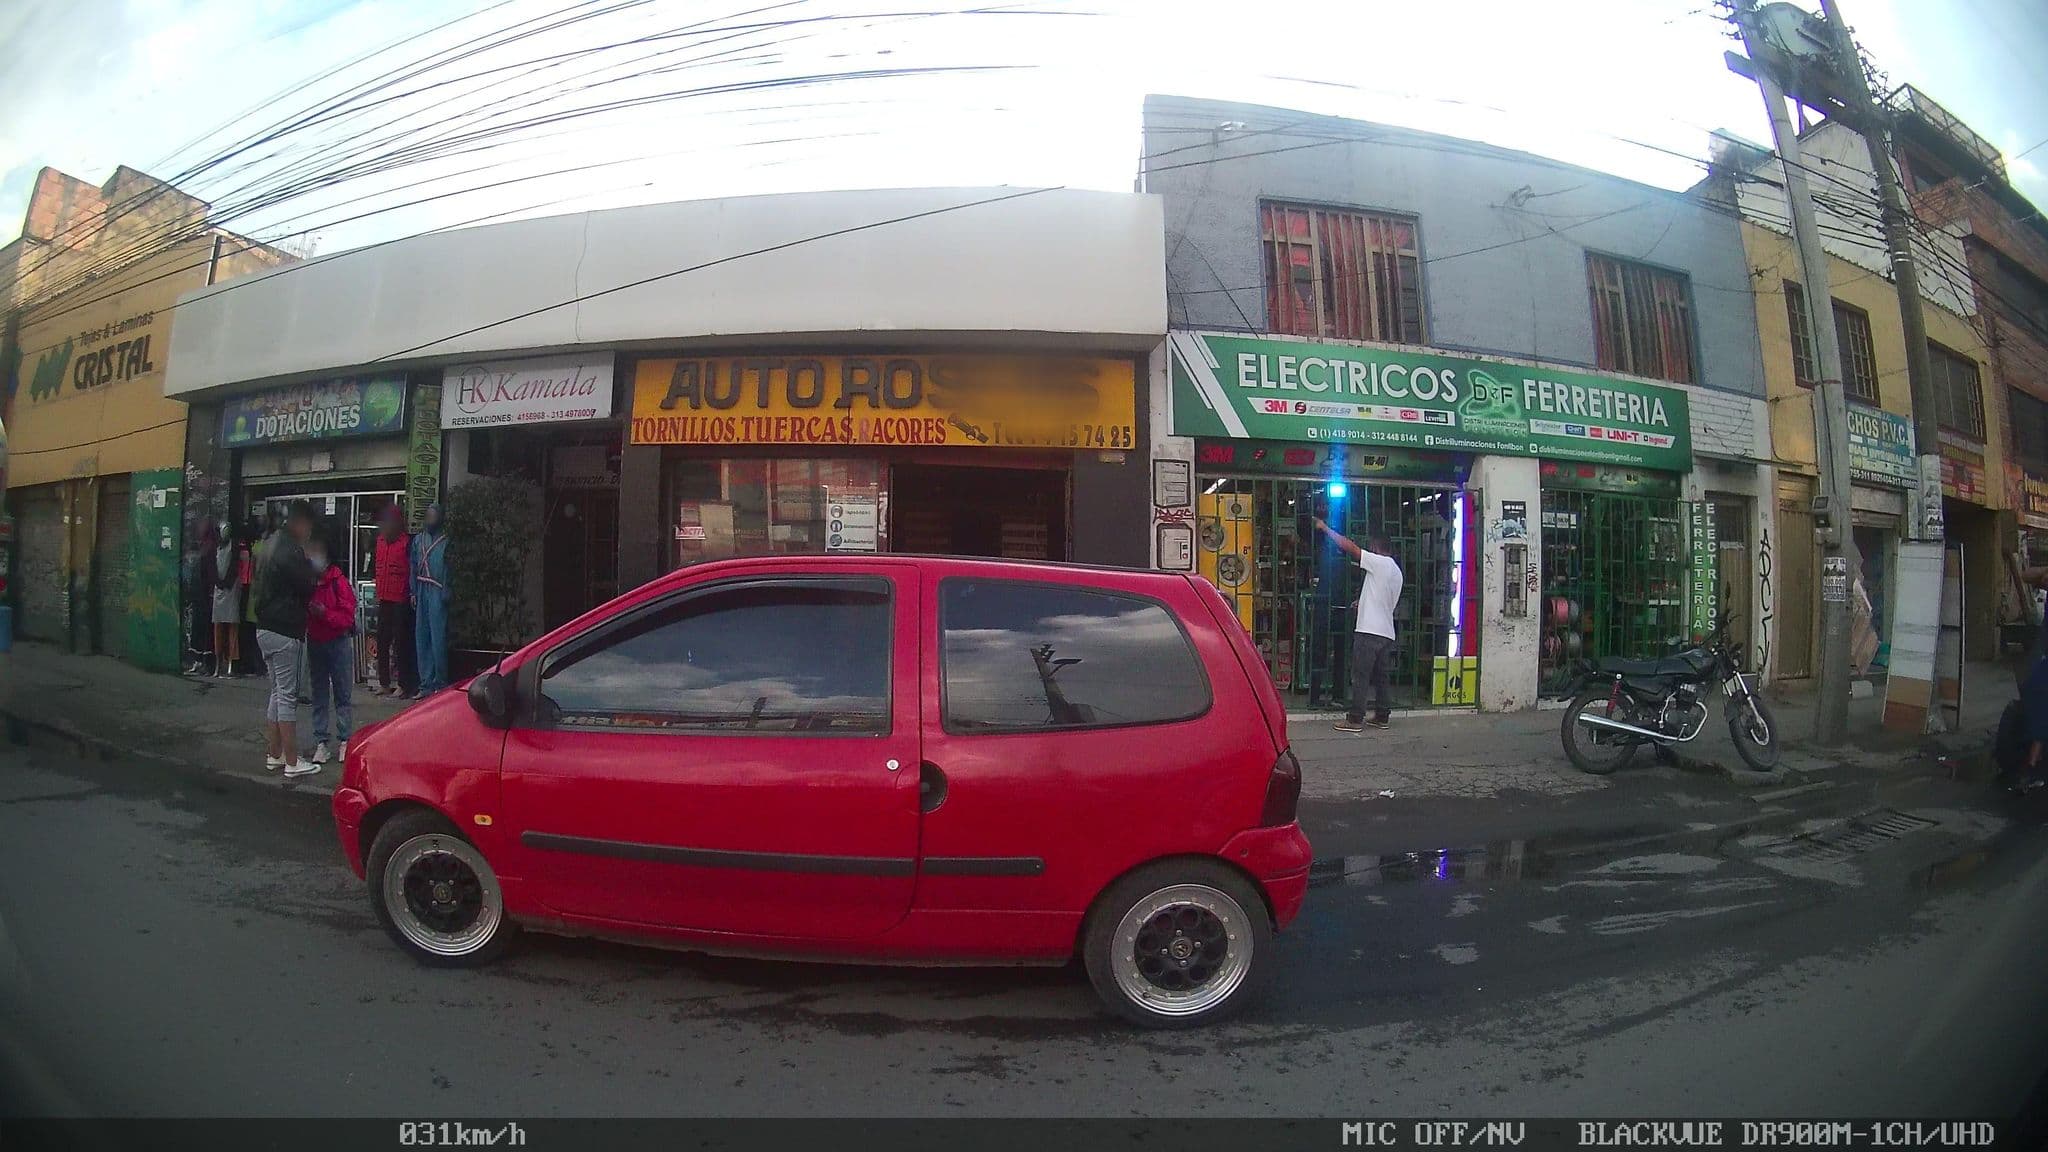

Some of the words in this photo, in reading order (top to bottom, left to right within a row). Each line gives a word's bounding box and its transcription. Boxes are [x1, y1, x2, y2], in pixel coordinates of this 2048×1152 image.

[74, 334, 153, 390] CRISTAL
[493, 365, 598, 402] Kamala
[1238, 353, 1459, 403] ELECTRICOS
[659, 358, 824, 410] AUTO
[1523, 378, 1669, 427] FERRETERIA
[255, 404, 361, 439] DOTACIONES
[1264, 400, 1288, 413] 3M
[1847, 411, 1880, 439] CHOS
[1332, 430, 1346, 438] 418
[1347, 430, 1366, 439] 9014
[1371, 431, 1386, 440] 312
[1608, 430, 1639, 442] UNI-T
[1693, 503, 1704, 629] FERRETERIA
[1706, 503, 1718, 631] ELECTRICOS
